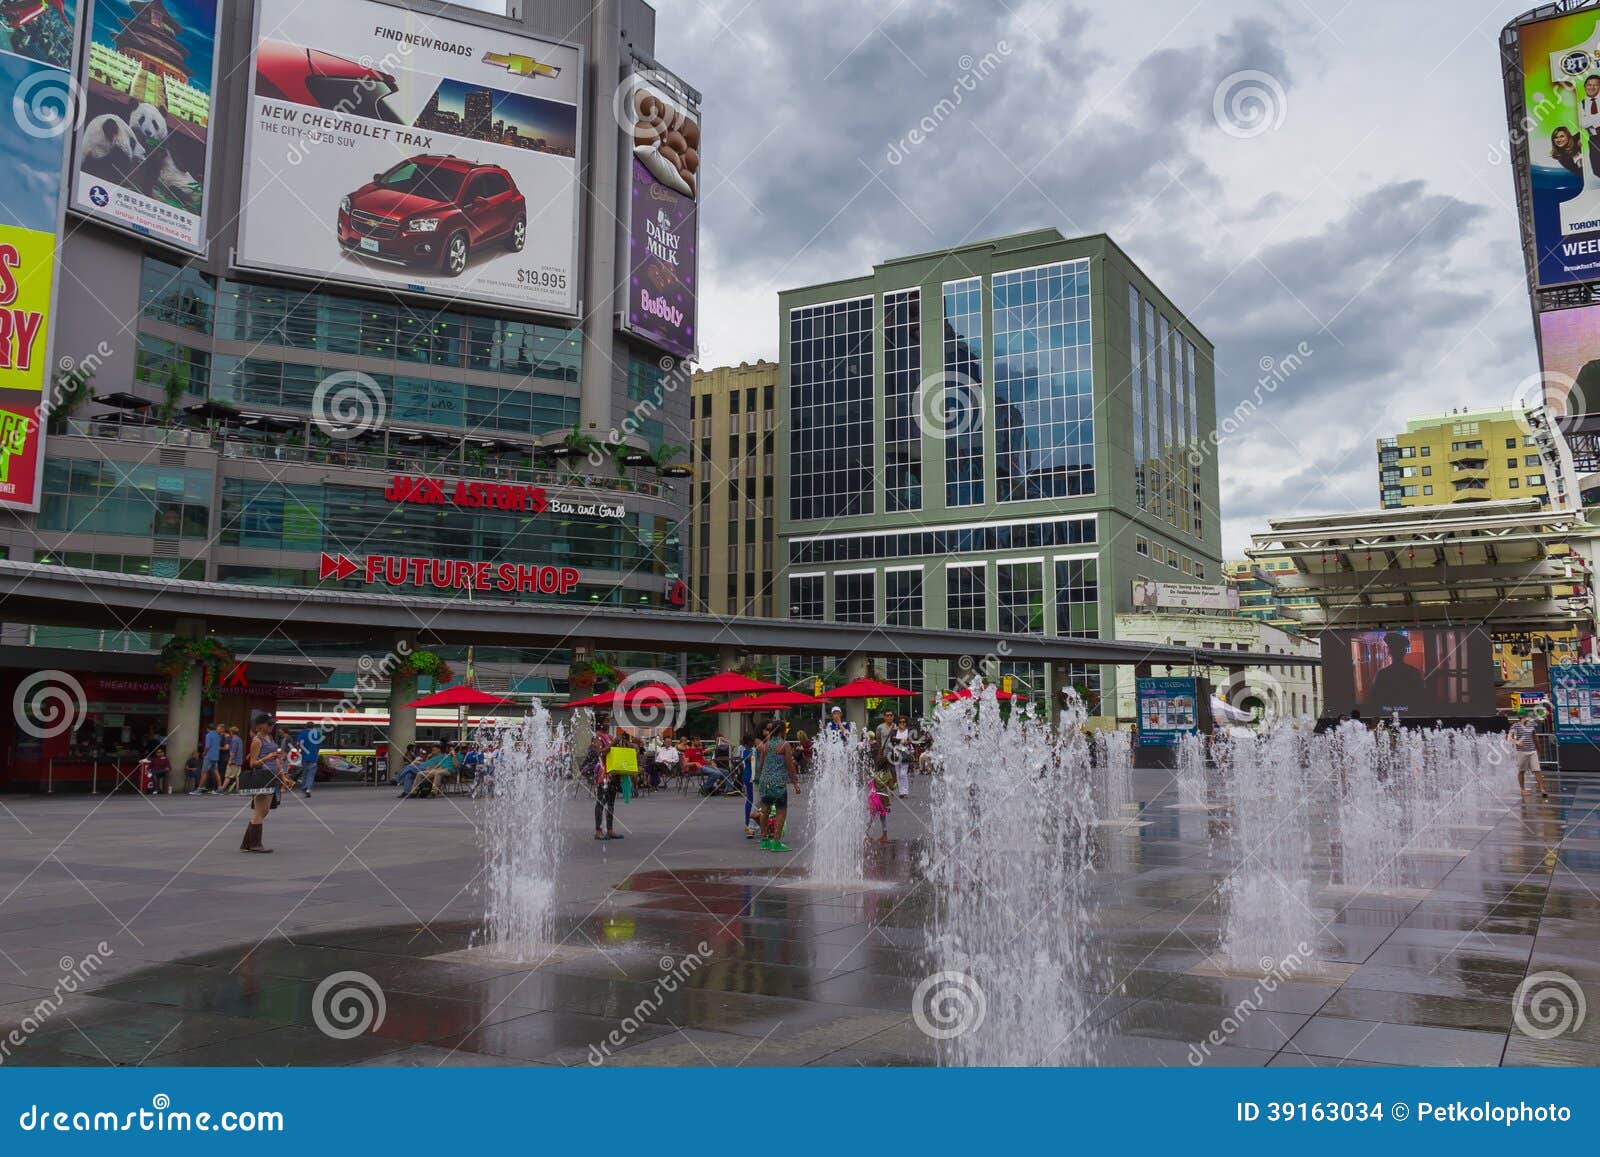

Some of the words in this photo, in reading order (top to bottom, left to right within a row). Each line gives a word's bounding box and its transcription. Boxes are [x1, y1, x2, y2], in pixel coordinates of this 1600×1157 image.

[374, 27, 403, 42] FIND
[404, 33, 433, 48] NEW
[433, 40, 473, 56] ROADS
[260, 121, 279, 133] THE
[337, 136, 356, 148] SUV
[261, 104, 298, 121] NEW
[302, 112, 391, 140] CHEVROLET
[395, 131, 433, 149] TRAX
[646, 217, 681, 250] DAIRY
[647, 236, 680, 266] MILK
[517, 268, 566, 289] $19,995
[641, 288, 684, 328] Bubbly
[384, 475, 446, 505] JACK
[452, 481, 549, 514] ASTOR'S
[549, 499, 574, 514] Bar
[577, 504, 596, 515] and
[599, 505, 626, 518] Grill
[365, 554, 493, 591] FUTURE
[497, 562, 580, 595] SHOP
